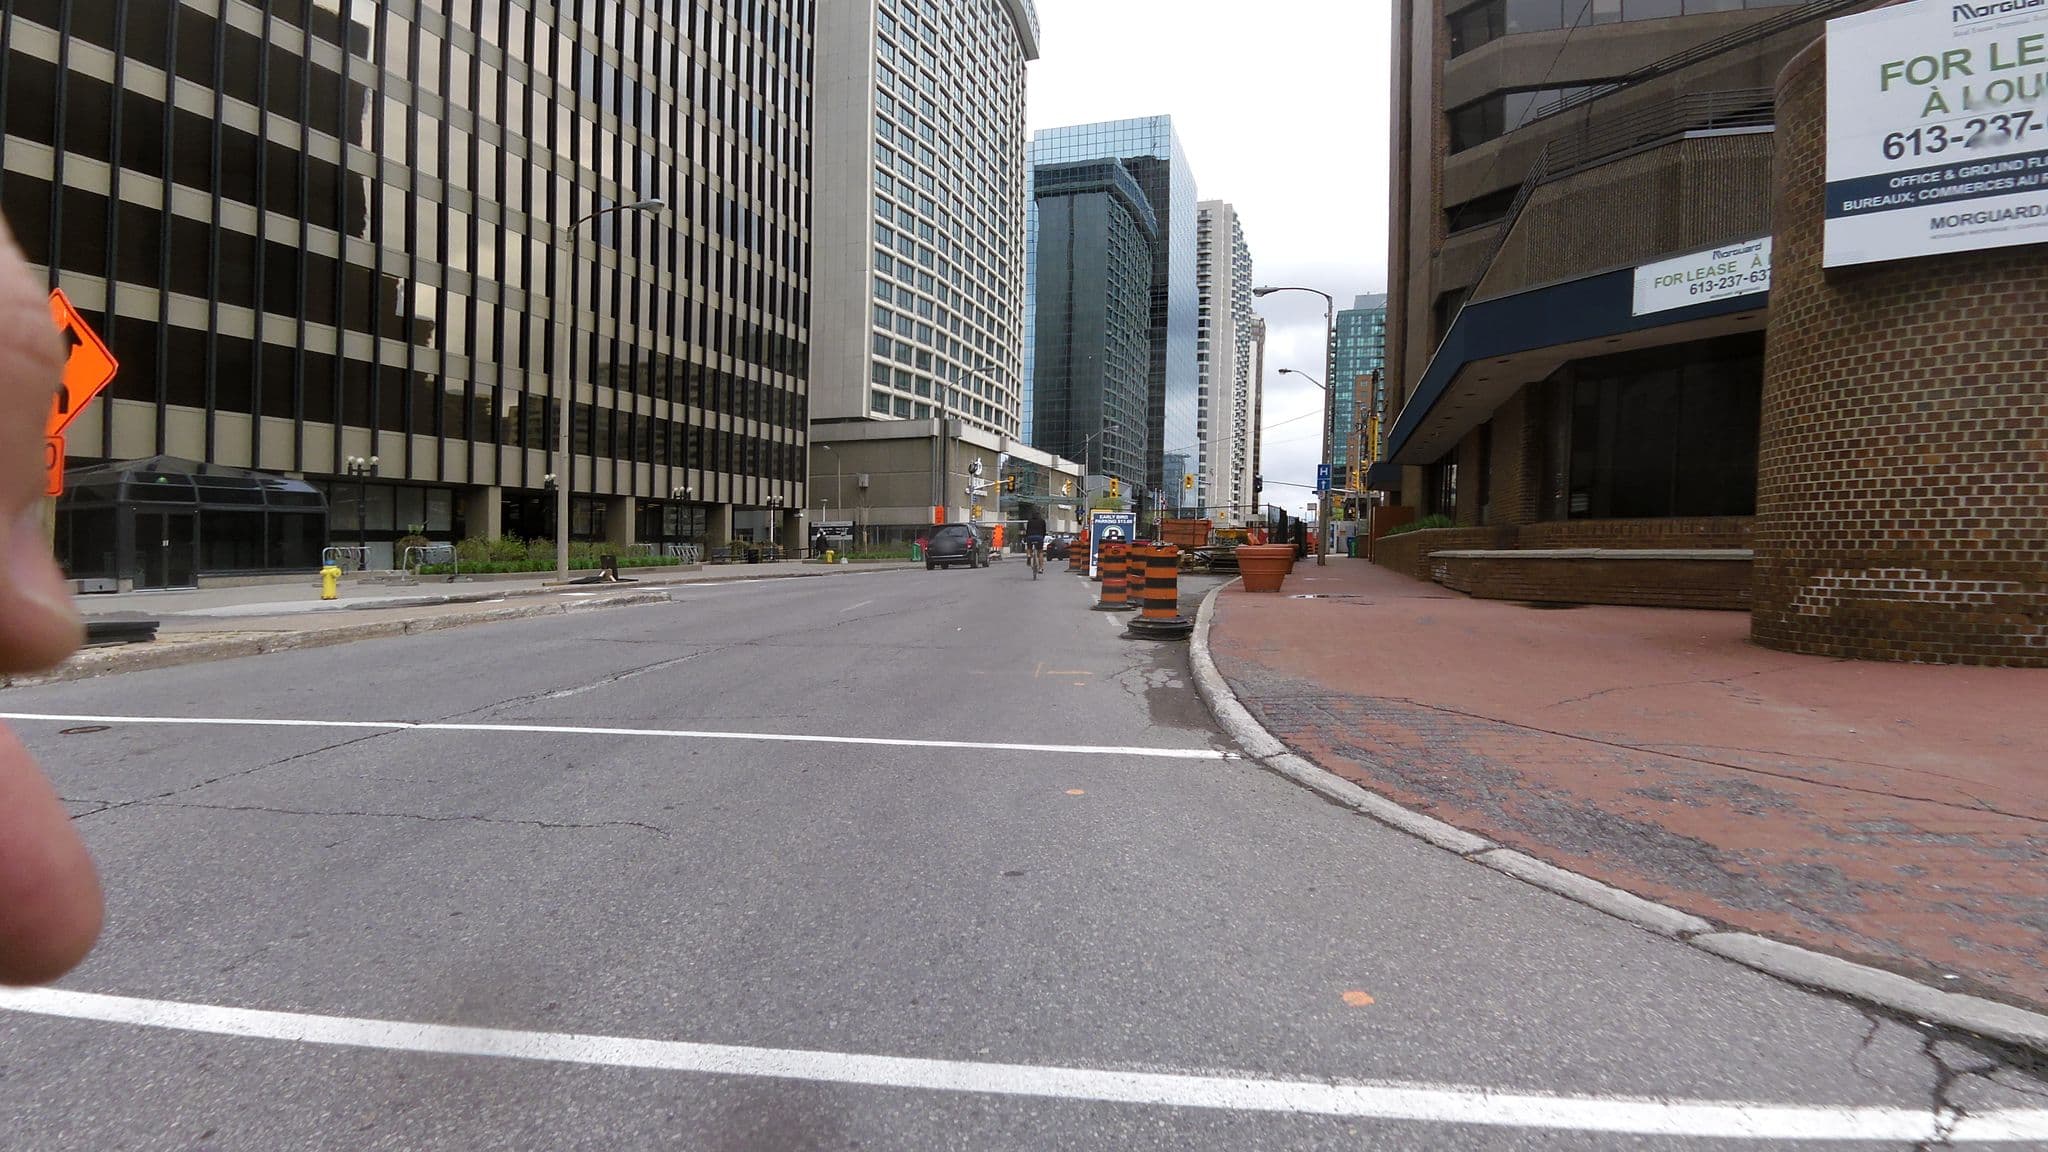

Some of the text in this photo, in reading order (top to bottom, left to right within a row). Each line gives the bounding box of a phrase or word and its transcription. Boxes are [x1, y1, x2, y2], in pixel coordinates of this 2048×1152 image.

[1881, 33, 2048, 92] FOR LE
[1921, 73, 2048, 118] À LOU
[1883, 110, 2048, 160] 613-237-
[1890, 171, 1941, 188] OFFICE
[1944, 169, 1956, 182] &
[1959, 158, 2024, 178] GROUND
[1918, 177, 2015, 200] COMMERCES
[2016, 173, 2039, 187] AU
[1654, 273, 1683, 288] FOR
[1687, 261, 1737, 281] LEASE
[1320, 467, 1328, 476] H
